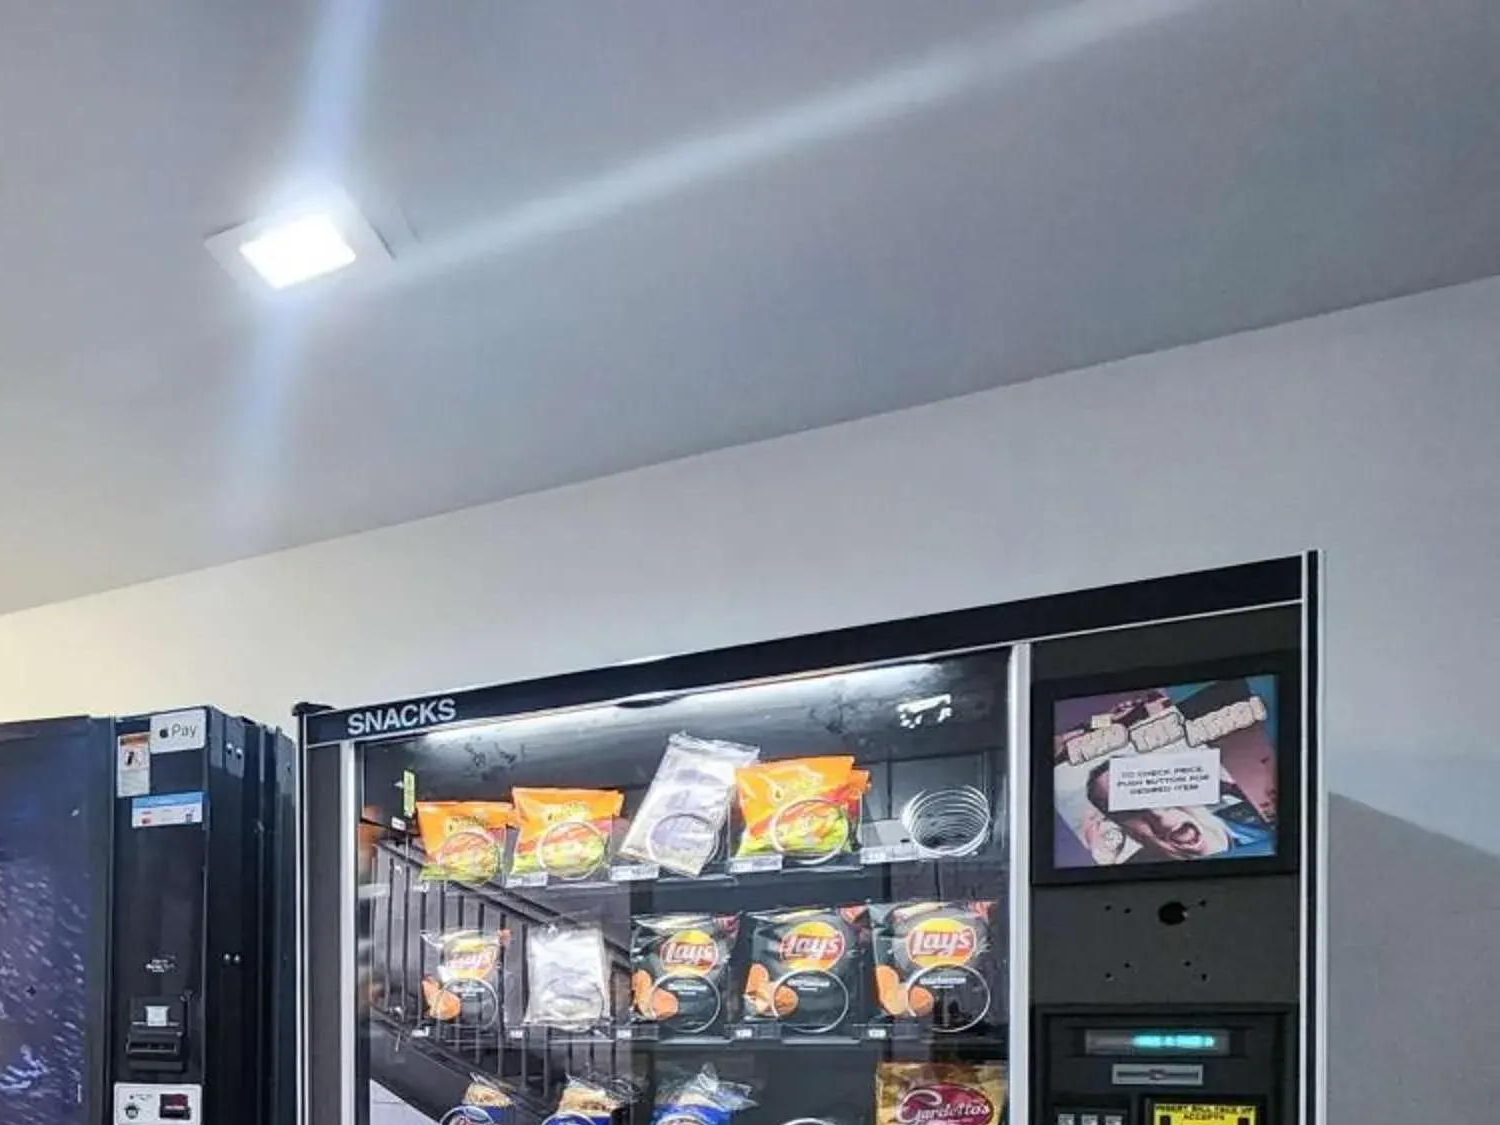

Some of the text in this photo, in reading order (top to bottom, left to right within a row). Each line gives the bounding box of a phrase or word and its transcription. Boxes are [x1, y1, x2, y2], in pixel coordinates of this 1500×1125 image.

[348, 698, 456, 735] SNACKS
[171, 723, 197, 738] Pay
[1137, 768, 1171, 777] CHECK
[1173, 766, 1204, 774] PRICE
[1145, 776, 1186, 785] BUTTON
